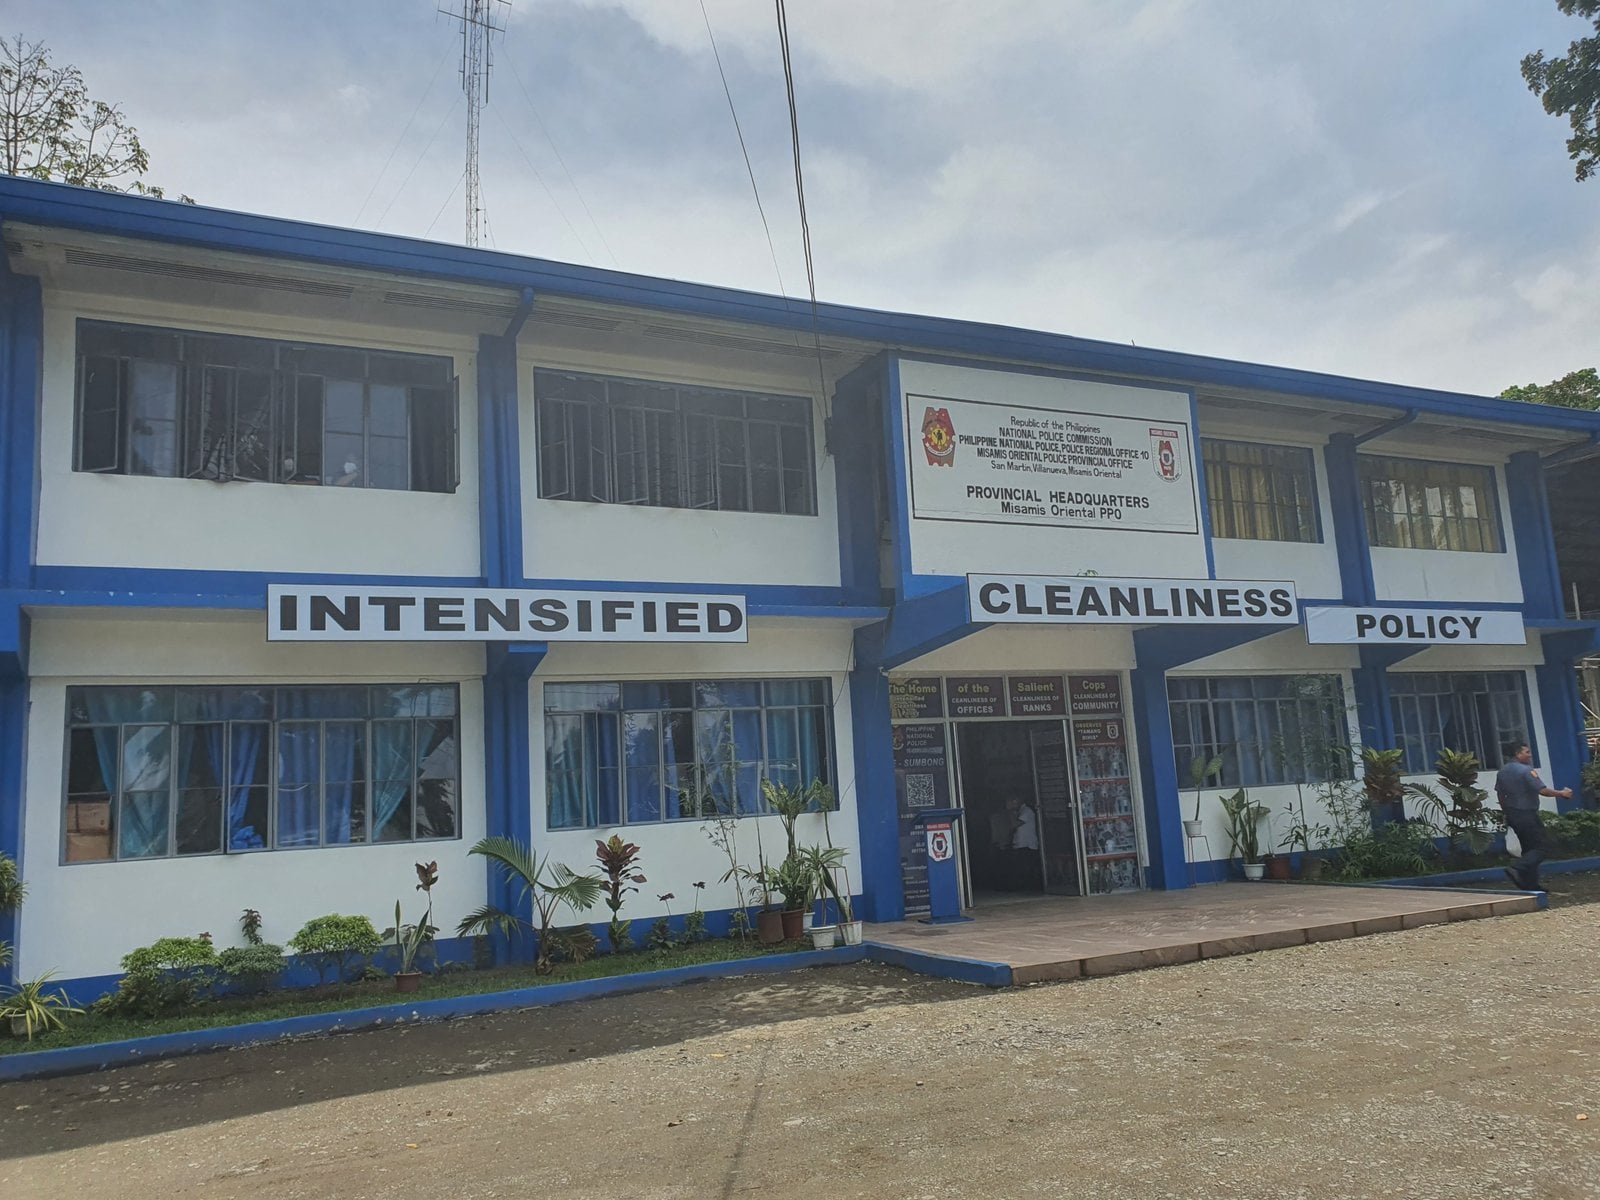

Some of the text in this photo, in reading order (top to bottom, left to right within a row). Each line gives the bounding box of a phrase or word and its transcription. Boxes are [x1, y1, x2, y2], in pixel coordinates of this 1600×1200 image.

[1010, 416, 1100, 433] Republic of the Philippines
[999, 427, 1112, 446] NATIONAL POLICE COMMISSION
[959, 435, 997, 447] PHILIPPINE
[999, 438, 1034, 450] NATIONAL
[1062, 444, 1084, 454] POLICE
[1085, 446, 1115, 456] REGIONAL
[1116, 448, 1139, 459] OFFICE
[1140, 451, 1149, 460] 10
[977, 448, 1133, 469] MISAMIS ORIENTAL POLICE PROVINCIAL OFFICE
[991, 460, 1005, 470] San
[1068, 466, 1092, 476] Misamis
[1093, 468, 1122, 478] Oriental
[966, 485, 1150, 508] PROVINCIAL HEADQUARTERS
[1001, 501, 1122, 520] Misamis Oriental PPO
[979, 582, 1293, 618] CLEANLINESS
[280, 595, 743, 633] INTENSIFIED
[1356, 614, 1482, 639] POLICY
[908, 684, 937, 693] Home
[958, 684, 968, 693] of
[972, 683, 989, 692] the
[1017, 682, 1054, 692] Salient
[1082, 680, 1105, 691] Cops
[1072, 701, 1119, 710] COMMUNITY
[904, 758, 944, 767] SUMBONG
